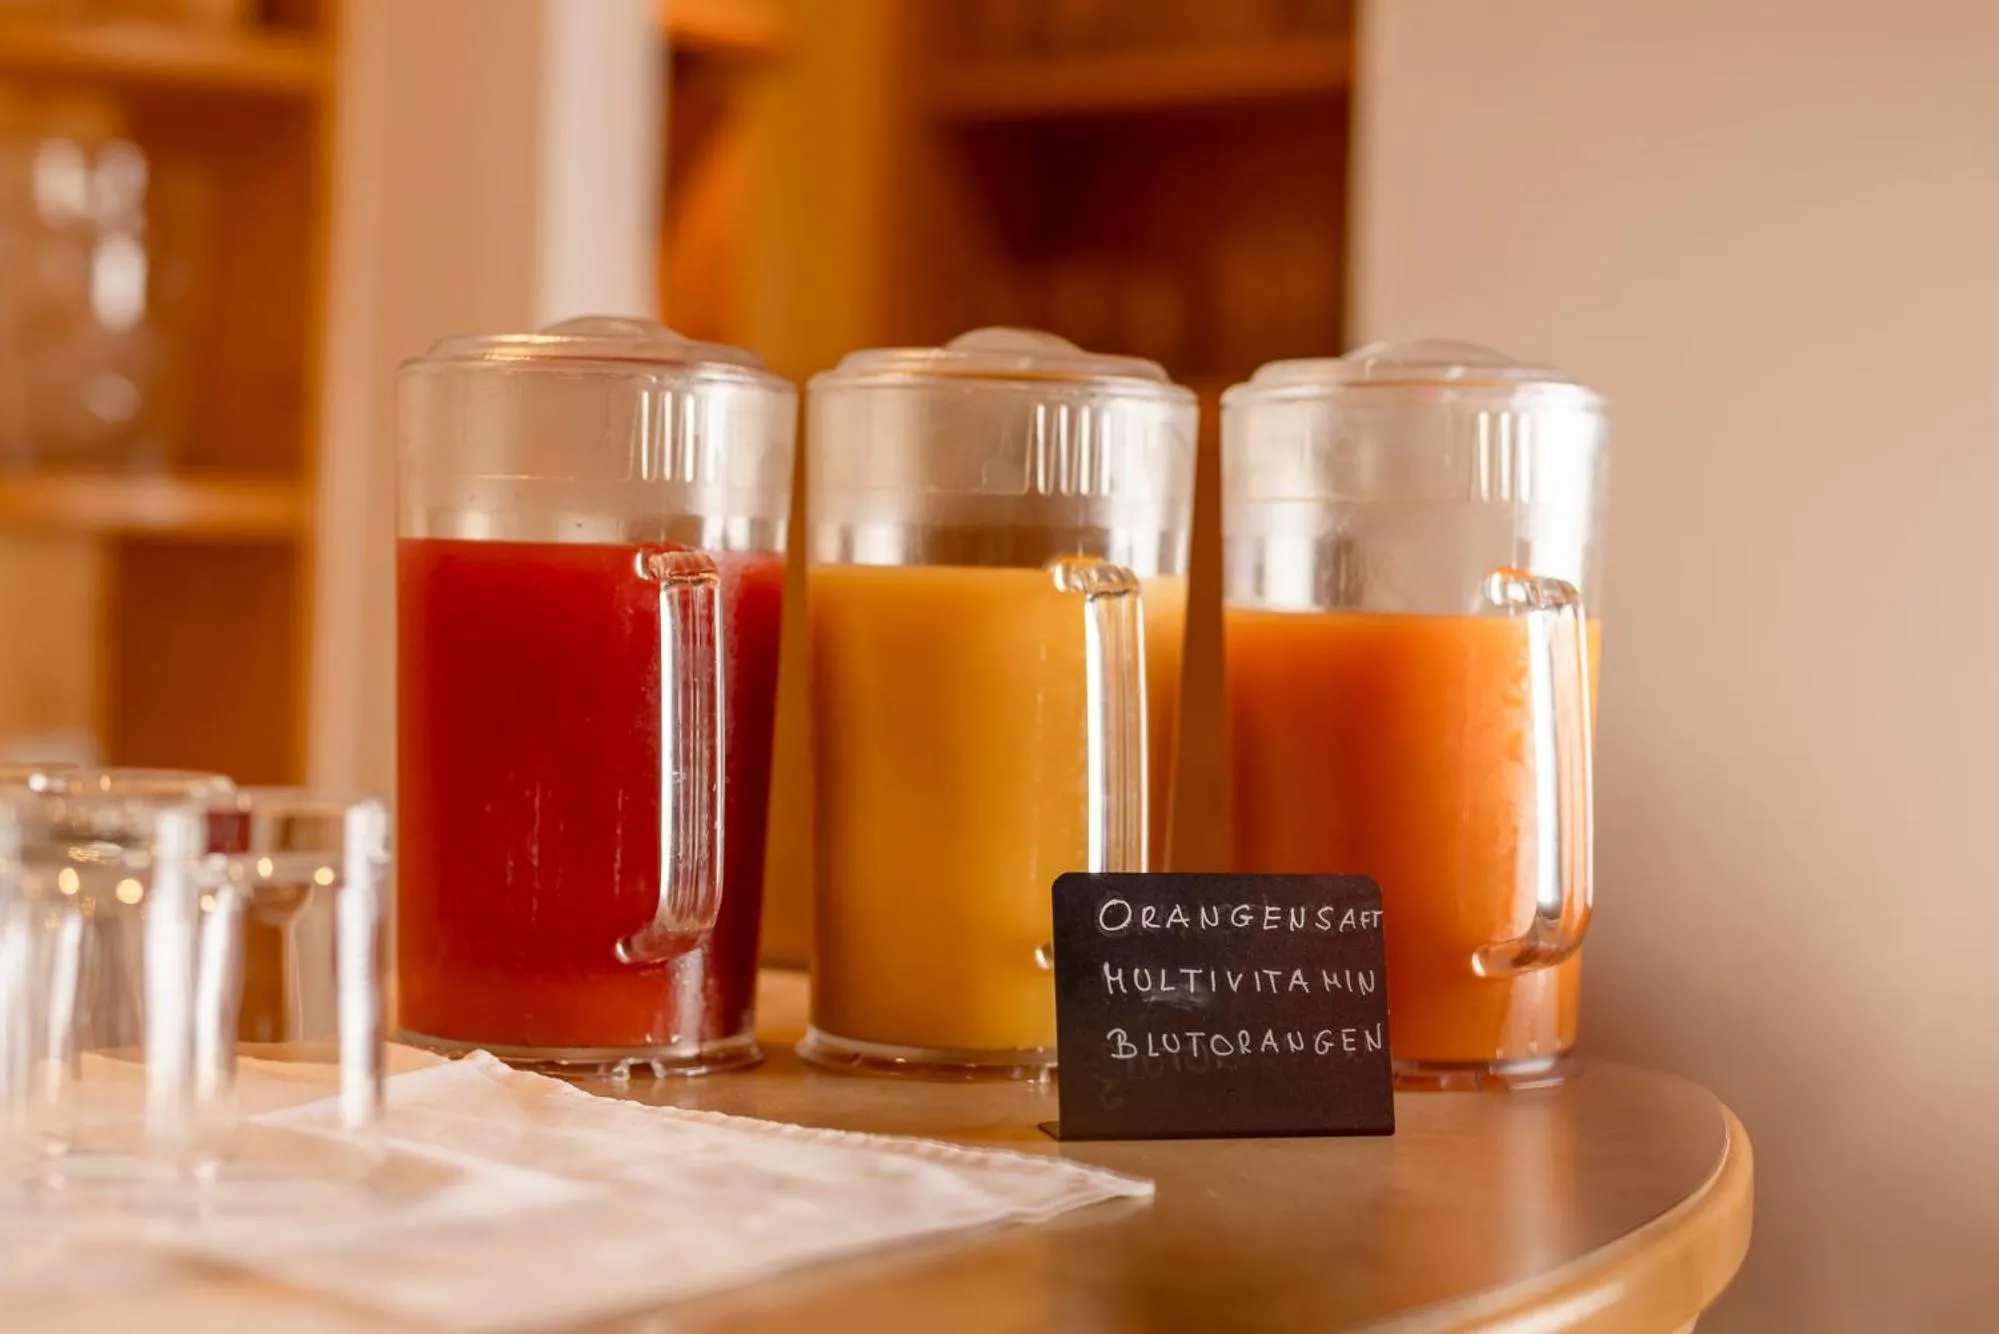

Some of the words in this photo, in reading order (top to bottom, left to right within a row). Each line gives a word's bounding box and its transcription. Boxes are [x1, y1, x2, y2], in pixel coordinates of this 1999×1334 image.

[1099, 899, 1383, 931] ORANGENSAFT
[1103, 962, 1375, 995] MULTIVITAMIN
[1106, 1023, 1383, 1059] BLUTORANGEN
